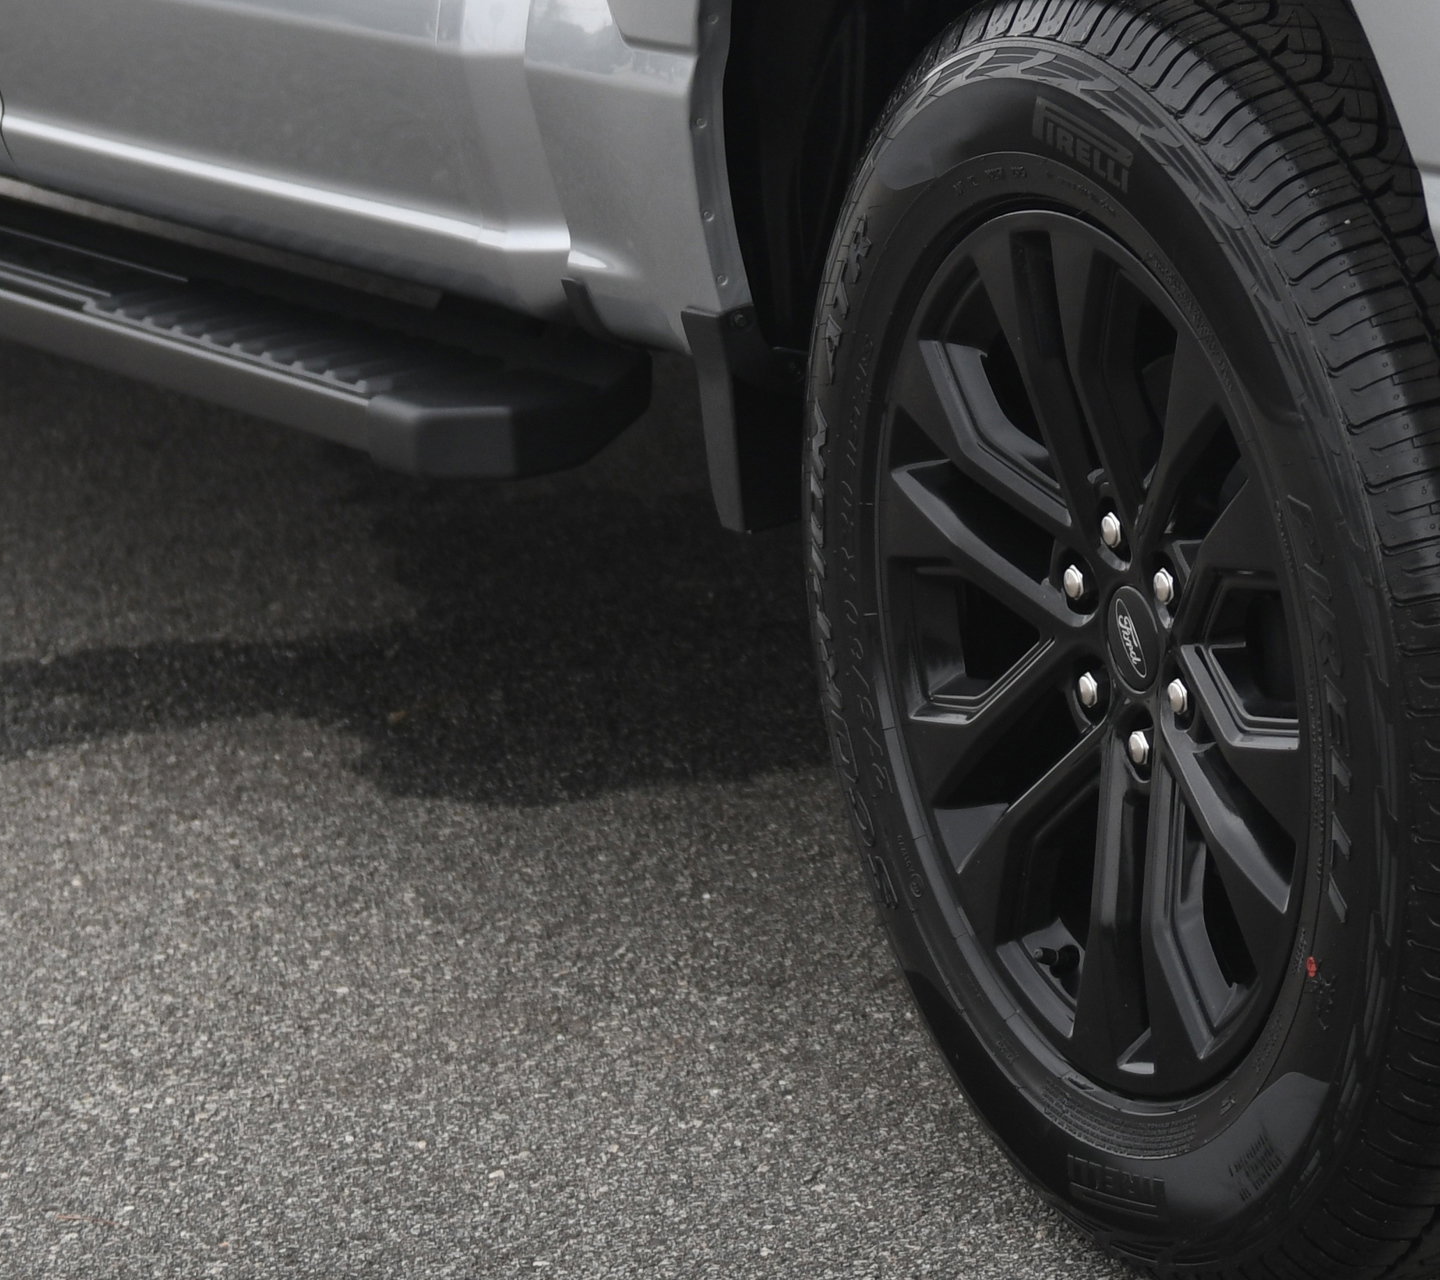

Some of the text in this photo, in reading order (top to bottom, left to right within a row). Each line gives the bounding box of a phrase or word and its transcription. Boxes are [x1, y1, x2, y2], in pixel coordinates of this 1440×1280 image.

[1031, 95, 1134, 194] PIRELLI
[1117, 613, 1143, 665] Ford
[1287, 494, 1353, 926] PIRELLI
